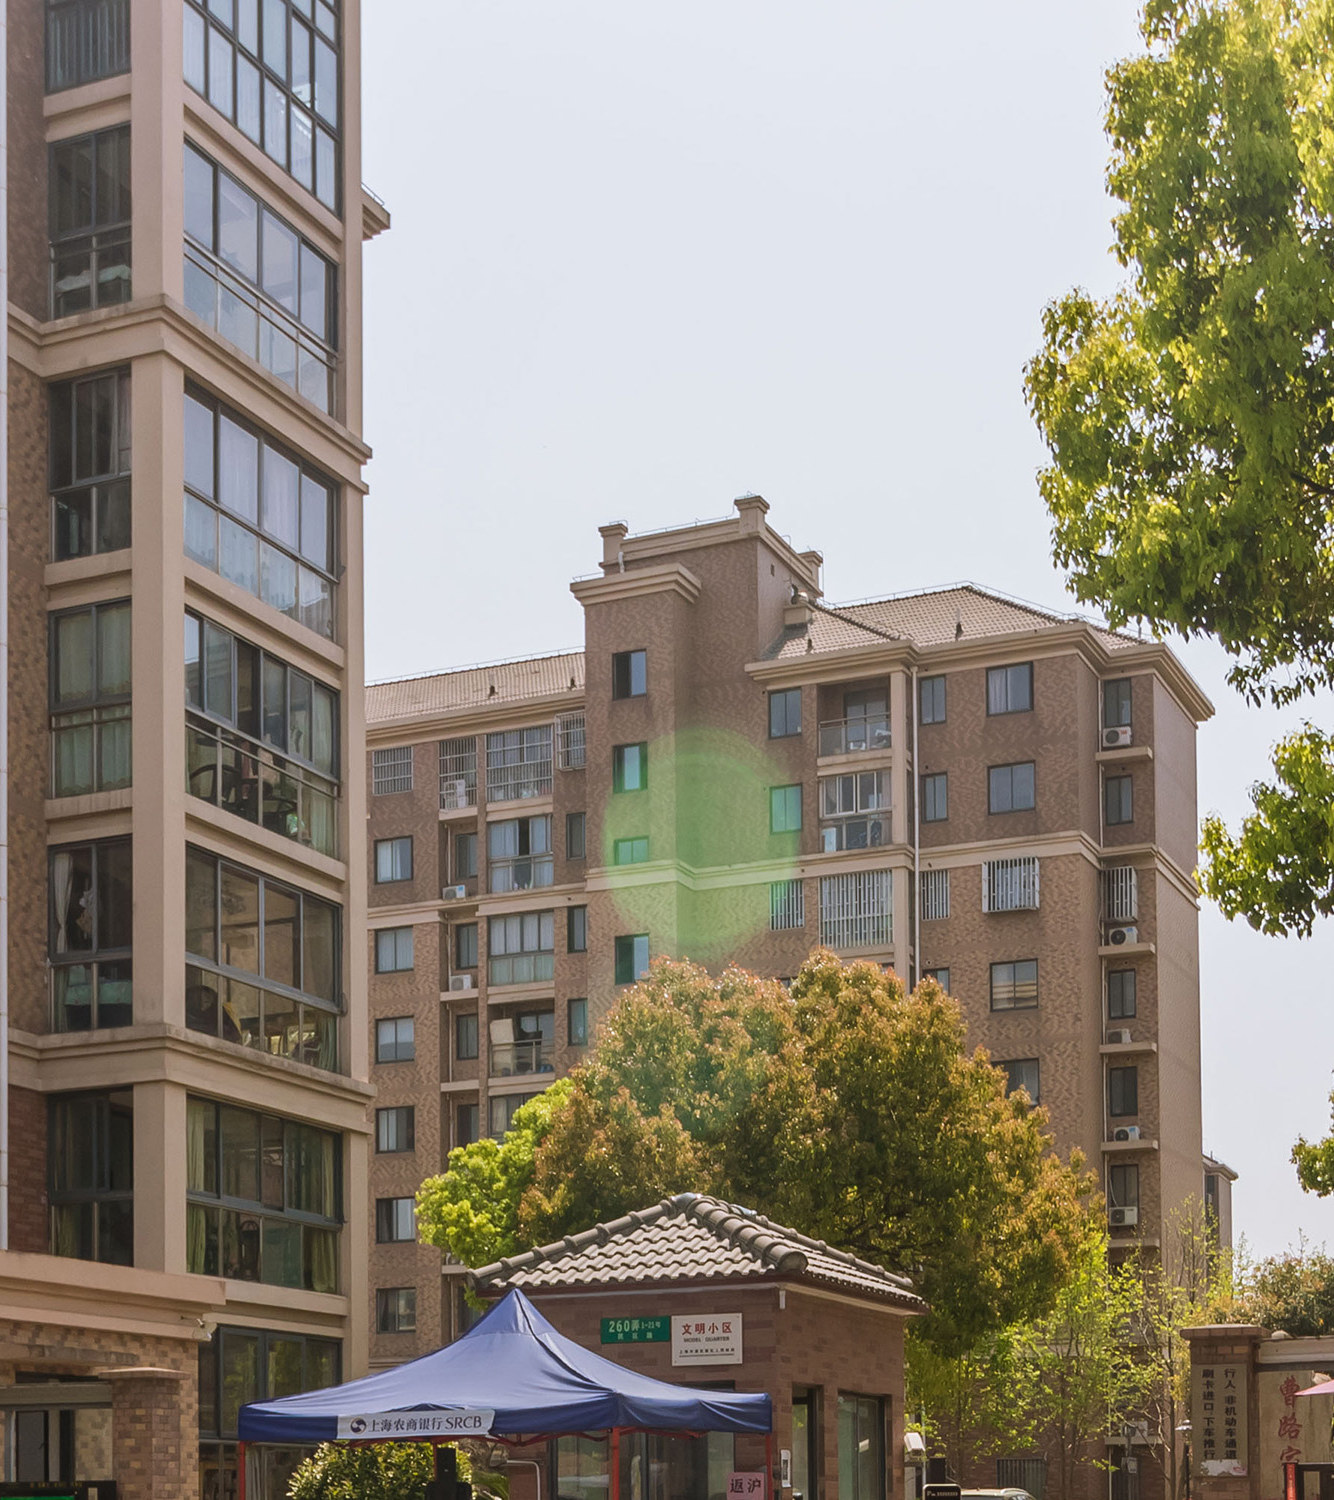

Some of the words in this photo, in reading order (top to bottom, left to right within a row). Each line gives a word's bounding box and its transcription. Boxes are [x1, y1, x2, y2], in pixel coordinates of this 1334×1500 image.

[682, 1321, 732, 1335] 文明小区
[368, 1417, 443, 1432] 上海农商银行
[445, 1415, 482, 1430] SRCB
[730, 1478, 761, 1493] 返沪
